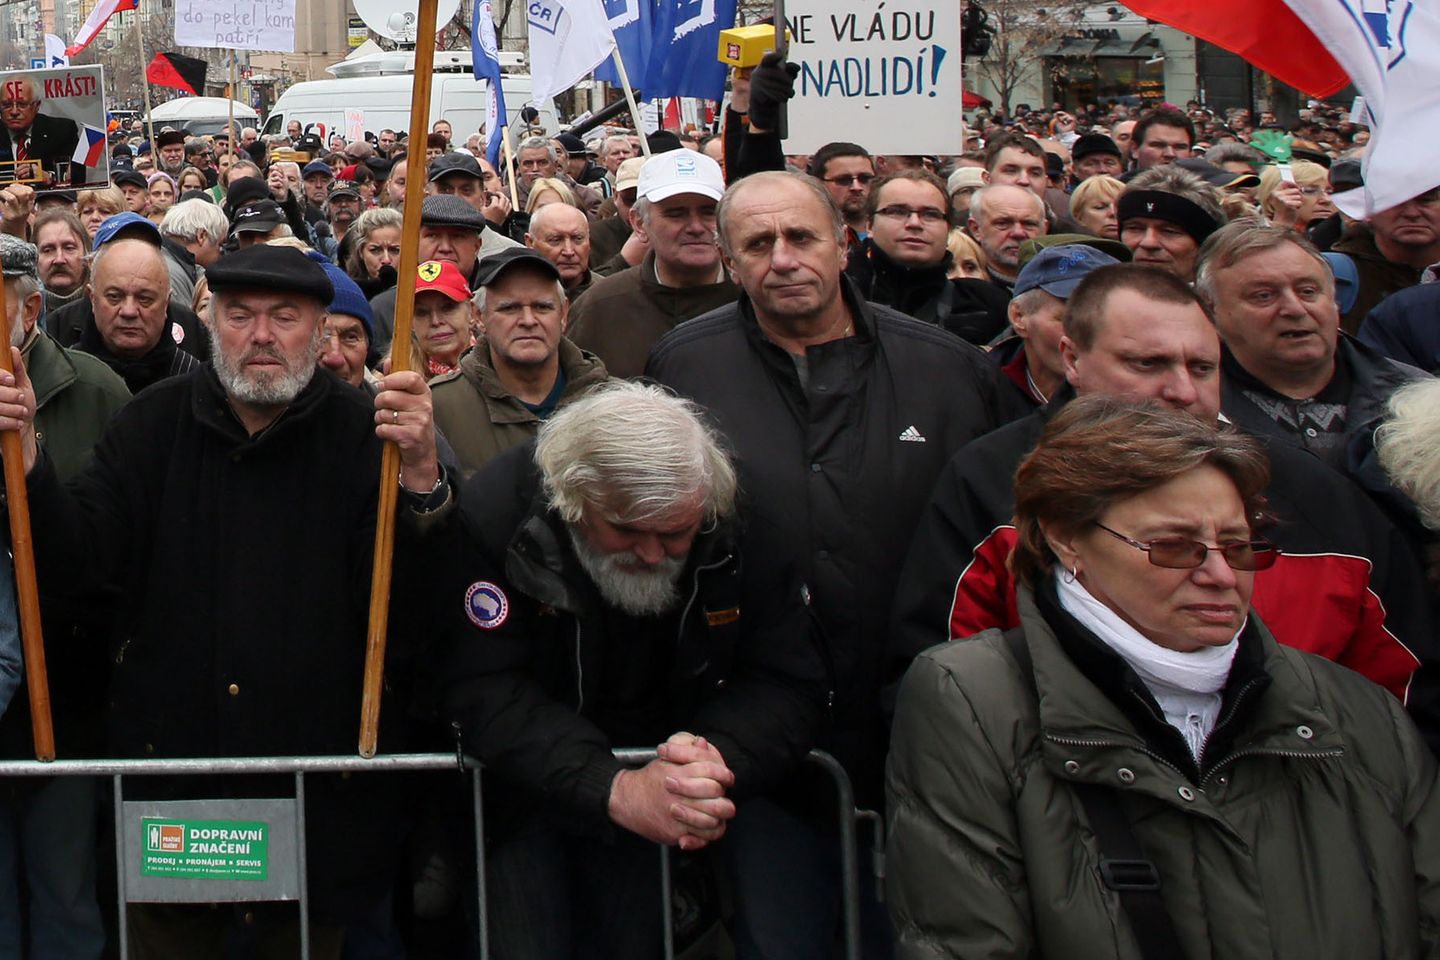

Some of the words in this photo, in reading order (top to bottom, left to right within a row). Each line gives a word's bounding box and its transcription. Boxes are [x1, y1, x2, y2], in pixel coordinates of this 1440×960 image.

[183, 7, 203, 24] do
[213, 3, 256, 31] pekel
[529, 2, 553, 22] ČR
[784, 14, 816, 44] NE
[830, 1, 935, 42] VLÁDU
[214, 26, 264, 47] patří
[801, 44, 948, 98] NADLIDÍ!
[6, 81, 24, 101] SE
[44, 72, 97, 99] KRÁST!
[190, 828, 263, 841] DOPRAVNÍ
[189, 841, 250, 855] ZNAČENÍ
[147, 856, 176, 865] PRODEJ
[185, 857, 227, 867] PRONÁJEM
